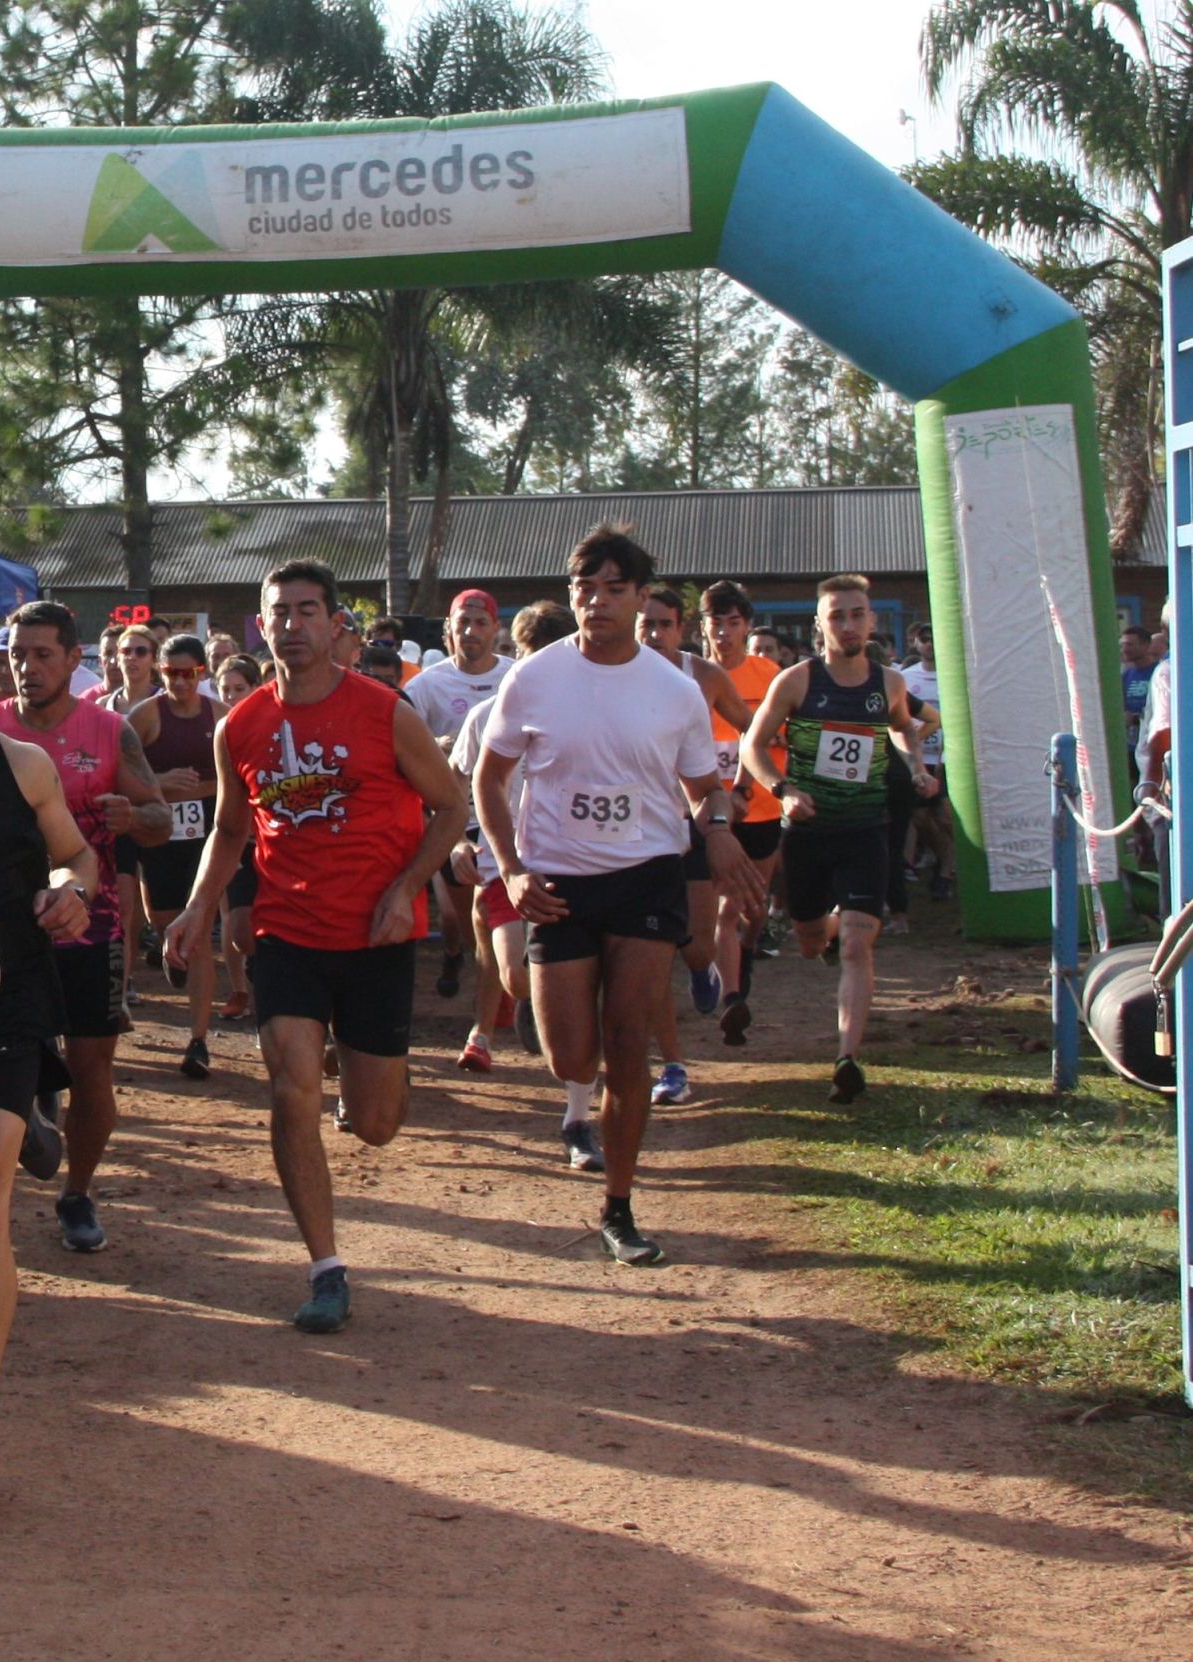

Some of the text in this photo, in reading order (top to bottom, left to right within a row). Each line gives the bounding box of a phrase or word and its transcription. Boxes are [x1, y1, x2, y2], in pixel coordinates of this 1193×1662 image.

[245, 144, 535, 204] mercedes
[248, 204, 452, 235] ciudad de todos
[829, 737, 861, 764] 28
[570, 792, 631, 822] 533
